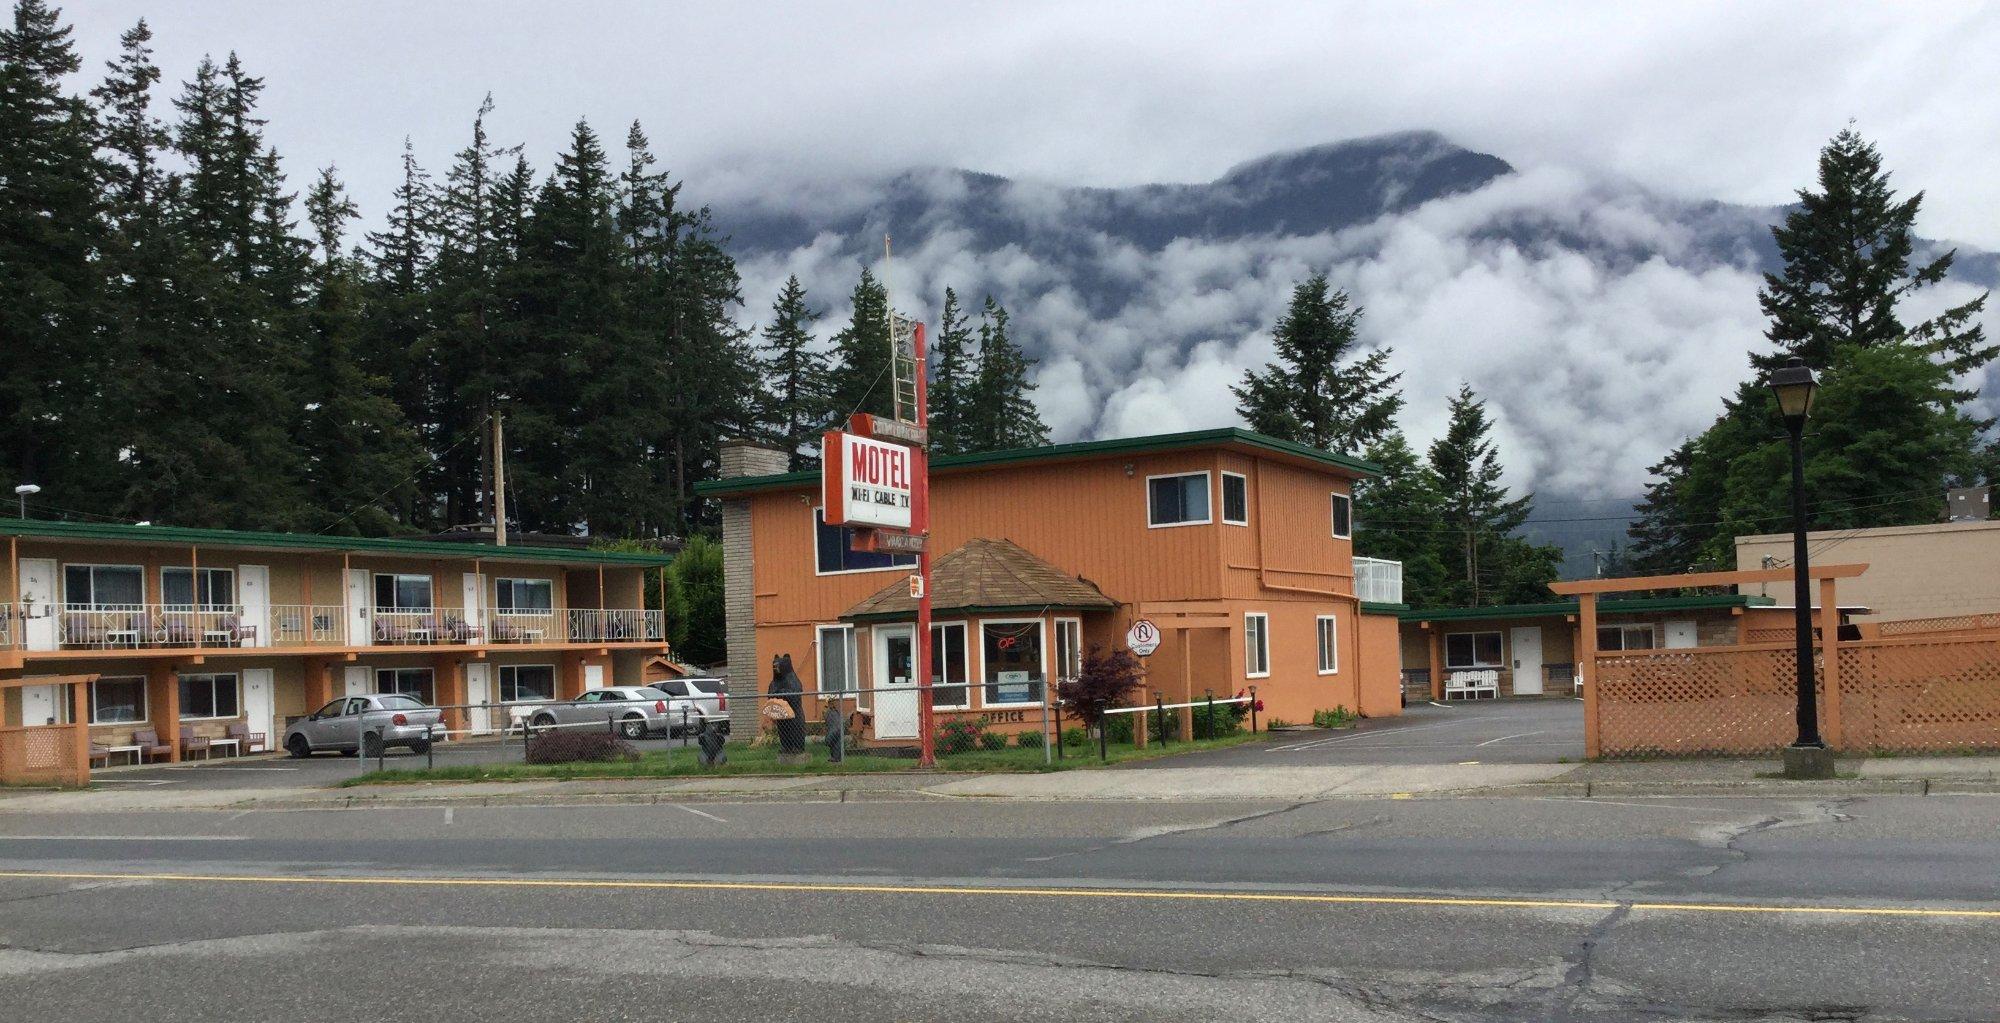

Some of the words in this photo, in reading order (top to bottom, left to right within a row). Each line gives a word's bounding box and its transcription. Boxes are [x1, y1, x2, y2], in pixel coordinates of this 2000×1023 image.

[852, 442, 909, 489] MOTEL
[852, 487, 870, 502] WI-FI
[875, 491, 895, 506] CABLE
[901, 495, 909, 507] TV
[982, 711, 1024, 723] OFFICE
